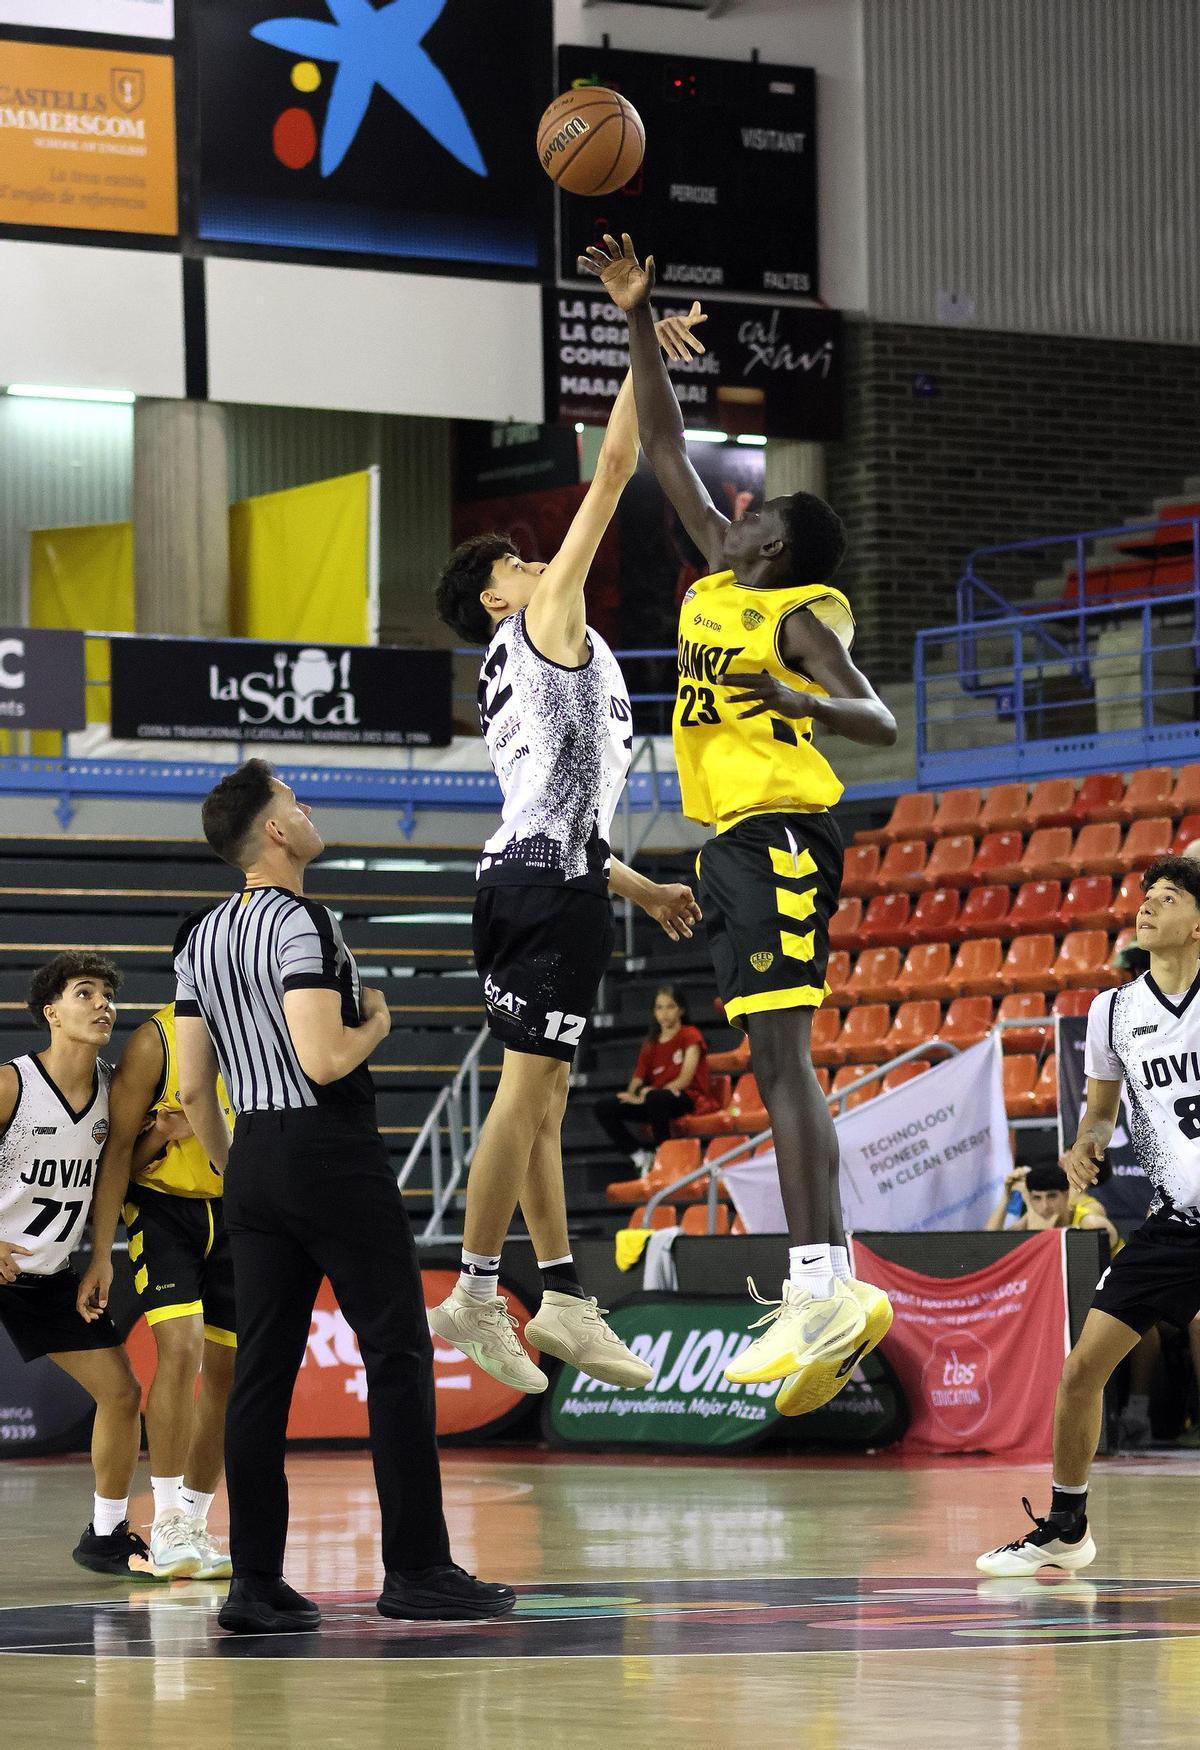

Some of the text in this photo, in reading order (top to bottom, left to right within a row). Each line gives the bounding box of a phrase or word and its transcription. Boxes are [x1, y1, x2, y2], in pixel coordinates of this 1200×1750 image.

[542, 115, 590, 169] Wilson
[559, 299, 587, 320] LA
[560, 323, 588, 342] LA
[702, 618, 722, 632] LEXOR
[238, 672, 361, 725] Soca
[680, 685, 722, 728] 23
[543, 1010, 588, 1046] 12
[860, 1104, 955, 1159] TECHNOLOGY
[1173, 1094, 1200, 1140] 8
[20, 1158, 99, 1189] JOVIA
[869, 1138, 930, 1176] PIONEER
[878, 1125, 992, 1194] IN CLEAN ENERGY
[942, 1349, 978, 1387] tbs
